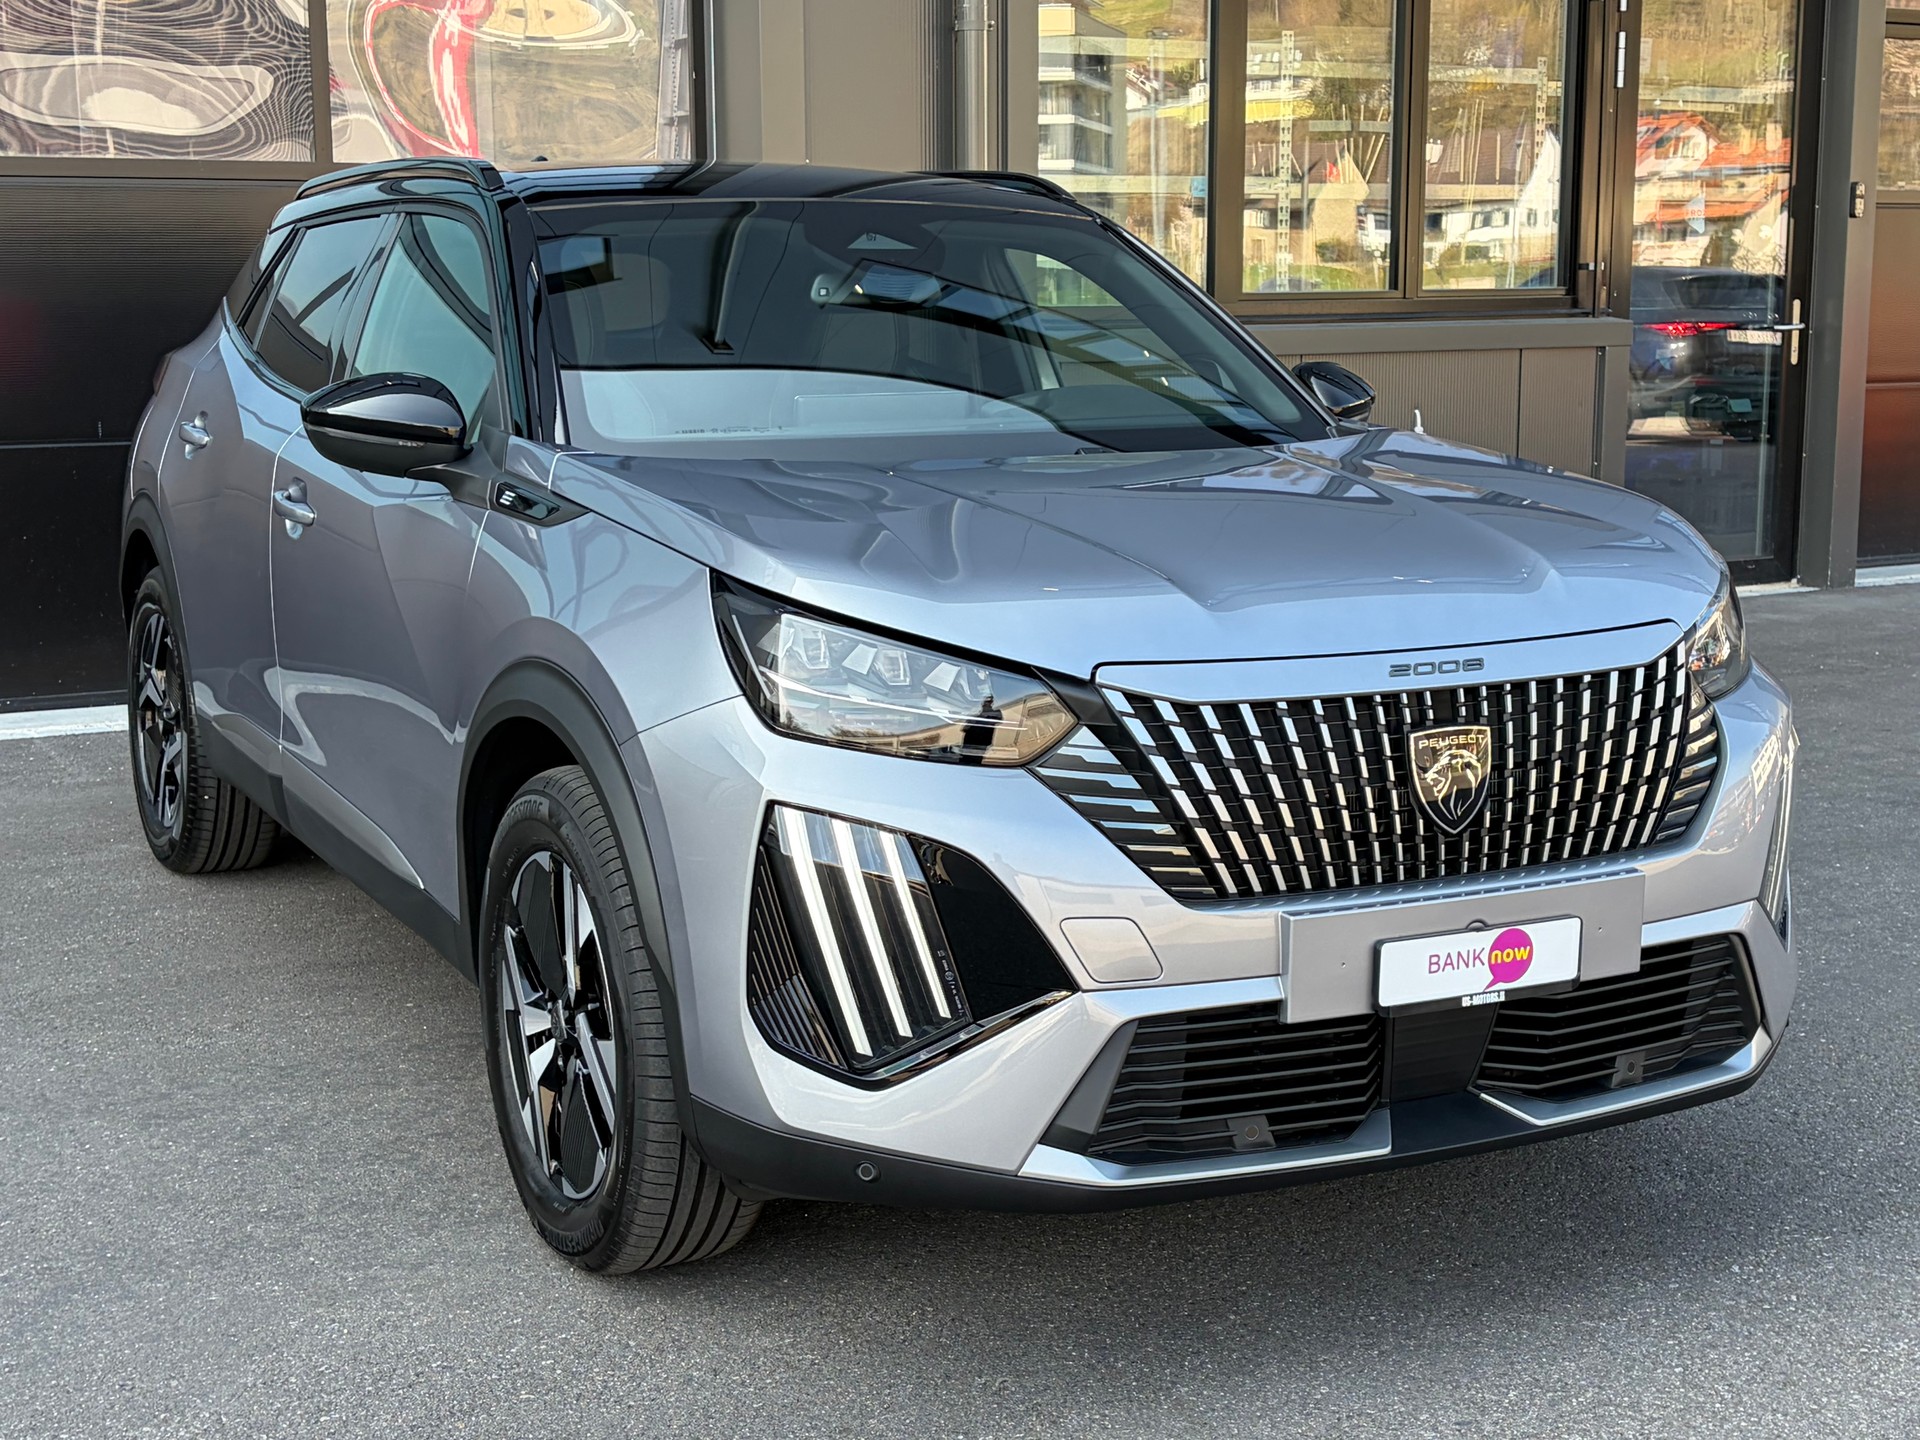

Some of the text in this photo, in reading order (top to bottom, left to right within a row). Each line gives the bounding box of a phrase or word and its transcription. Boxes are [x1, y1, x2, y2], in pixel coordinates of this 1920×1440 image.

[1388, 656, 1485, 678] 2008
[1418, 734, 1485, 750] PEUGEOT
[1428, 945, 1530, 974] BANK now
